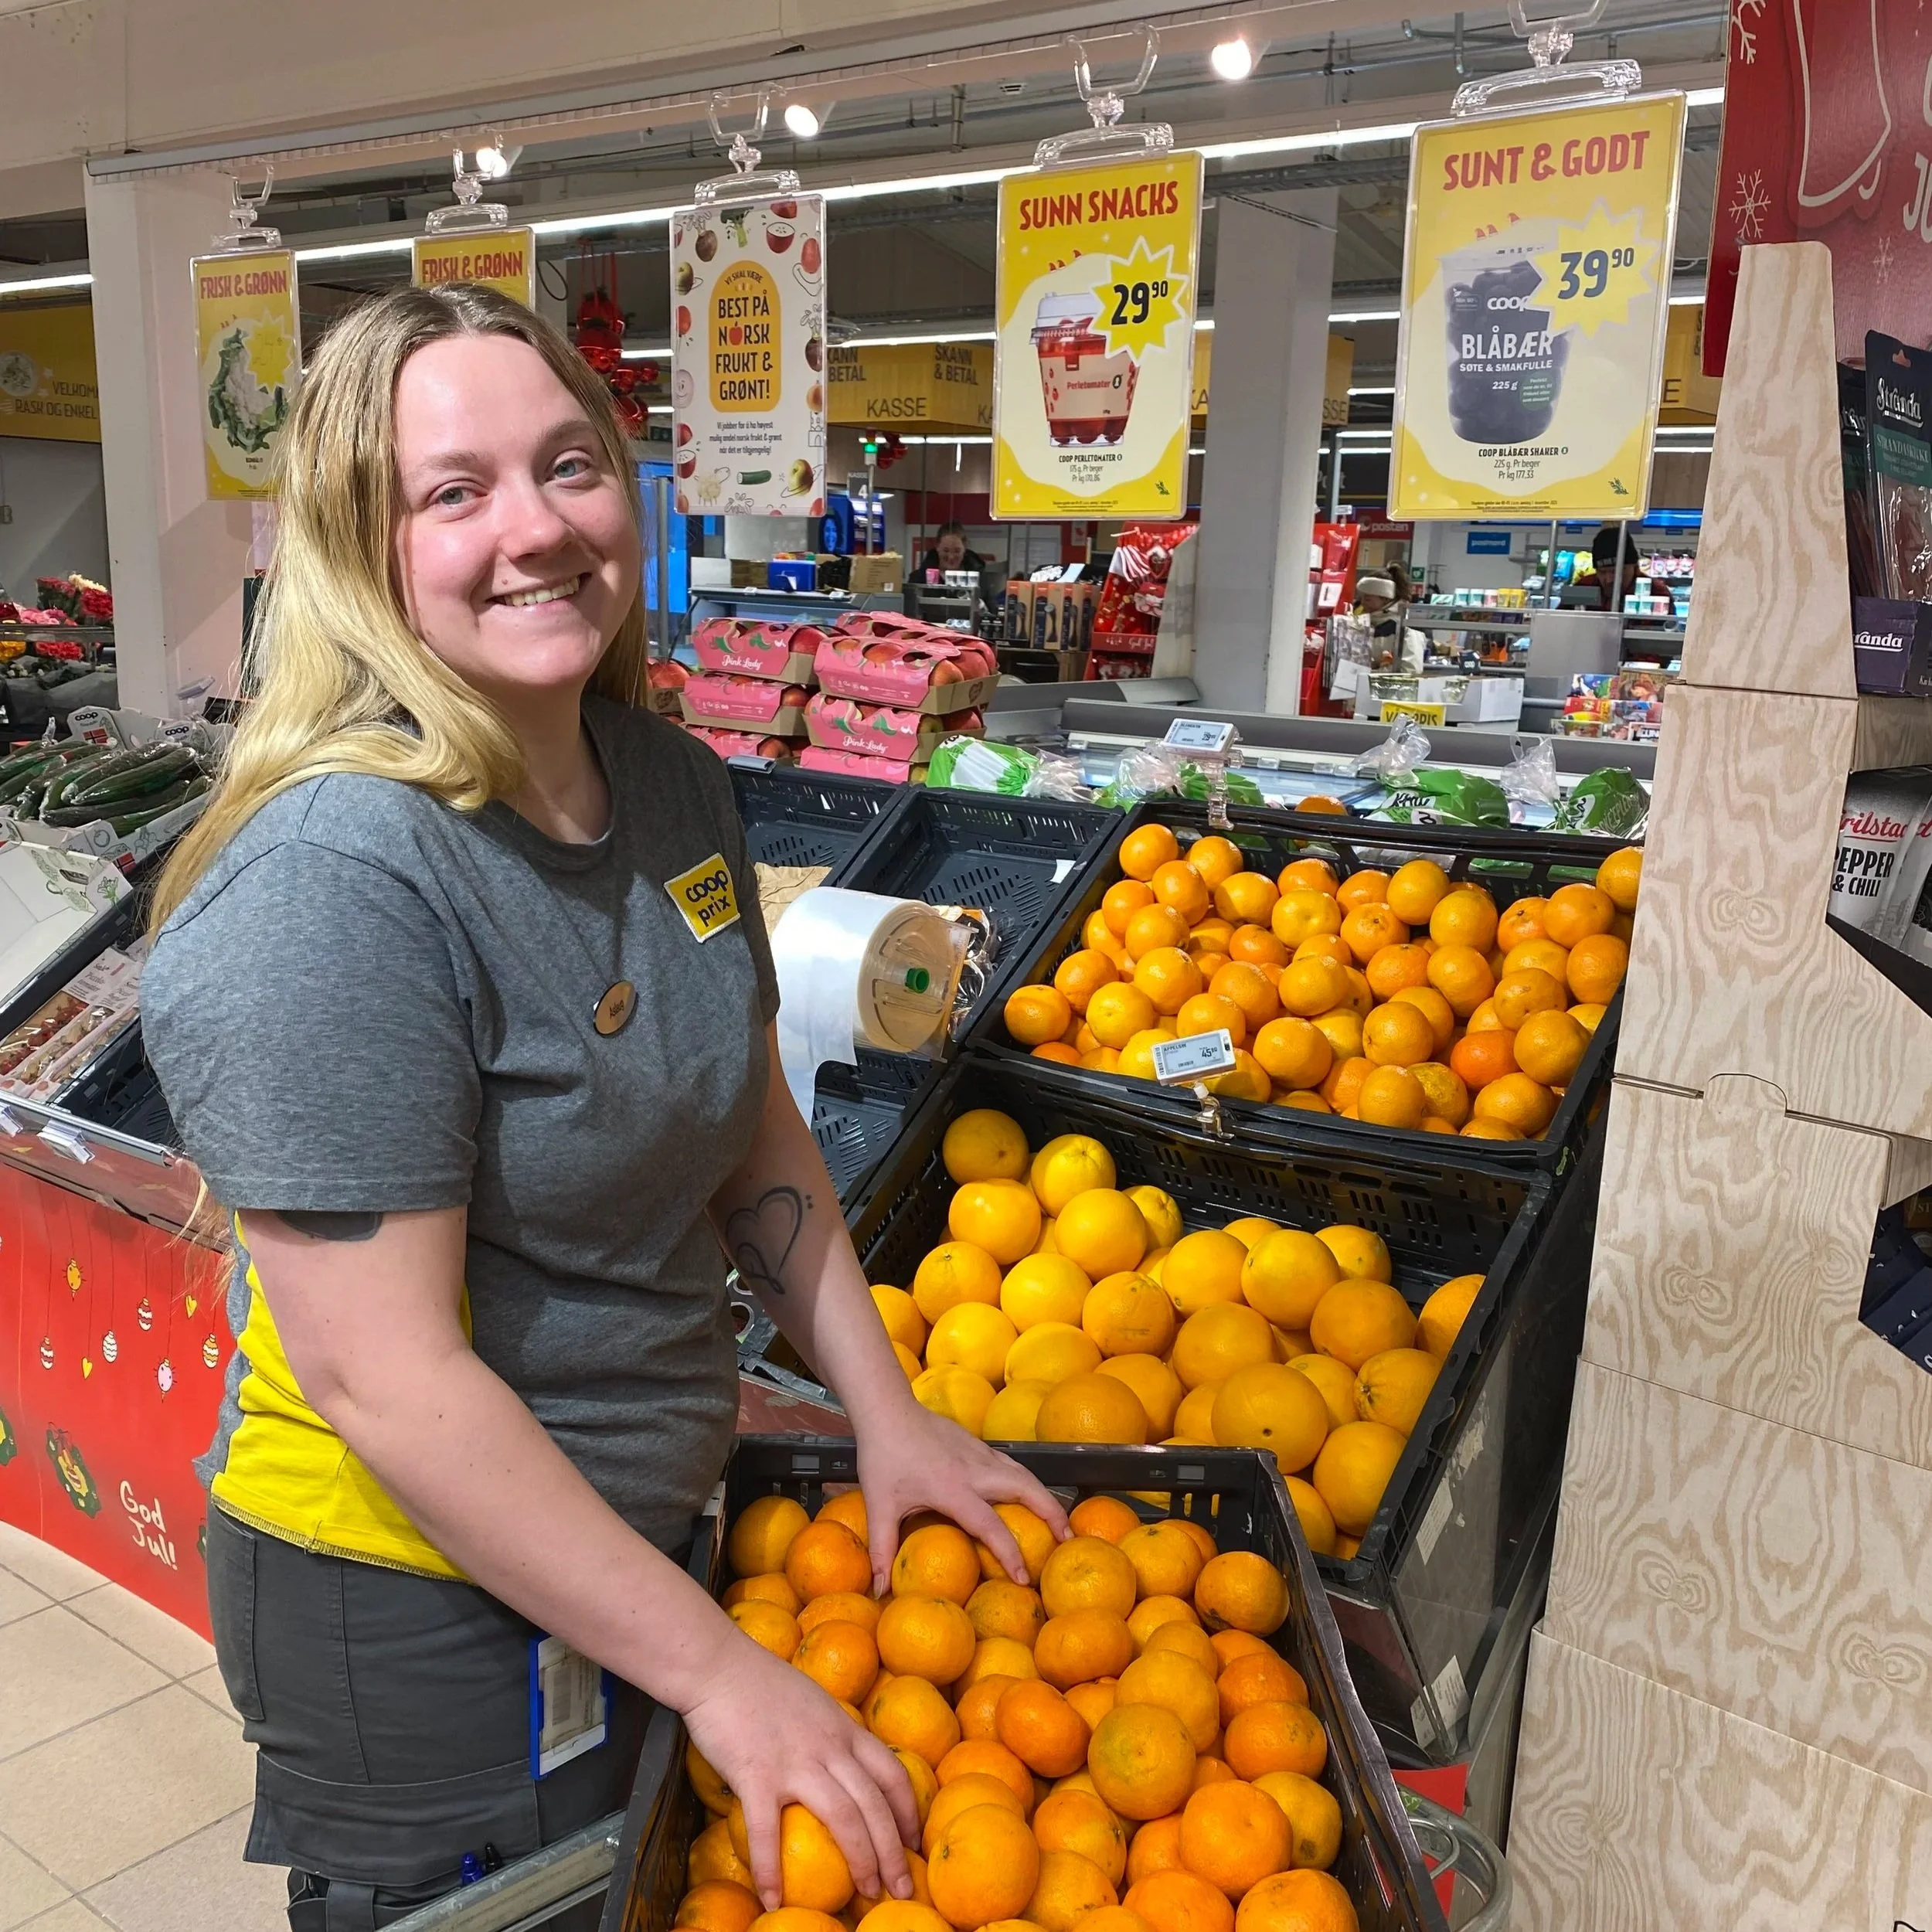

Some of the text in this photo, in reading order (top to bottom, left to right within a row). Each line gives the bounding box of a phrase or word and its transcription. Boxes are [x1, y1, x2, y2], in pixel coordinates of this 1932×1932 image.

[1443, 131, 1650, 190] SUNT & GODT
[1019, 181, 1179, 230] SUNN SNACKS
[421, 250, 523, 283] FRISK & GRØNN
[1558, 247, 1634, 299] 39 90
[201, 270, 287, 299] FRISK & GRØNN
[719, 289, 770, 318] BEST PÅ
[1111, 281, 1168, 325] 29 90
[1462, 325, 1553, 359] BLÅBÆR
[716, 352, 773, 373] FRUKT &
[828, 347, 859, 363] KANN
[934, 345, 973, 365] SKANN
[1460, 363, 1483, 372] SØTE
[1495, 359, 1553, 372] SMAKFULLE
[828, 366, 866, 382] BETAL
[934, 364, 978, 385] & BETAL
[719, 379, 770, 400] GRØNT!
[1492, 381, 1509, 389] 225
[15, 399, 97, 420] RASK OG ENKEL
[866, 397, 927, 418] KASSE
[1322, 398, 1347, 421] SSE
[1059, 453, 1115, 463] COOP PERLETOMATER
[1479, 446, 1559, 457] COOP BLÅBÆR SHAKER
[1855, 631, 1903, 648] randa
[722, 655, 764, 670] Pink Lady
[75, 711, 98, 721] coop
[165, 726, 189, 736] coop
[843, 736, 889, 753] Pink Lady
[1840, 811, 1906, 838] rilsta
[1835, 846, 1895, 877] EPPER
[685, 869, 729, 903] coop
[1832, 874, 1881, 896] & CHILI
[697, 895, 731, 927] prix
[120, 1480, 166, 1532] God
[128, 1515, 178, 1570] Jul!
